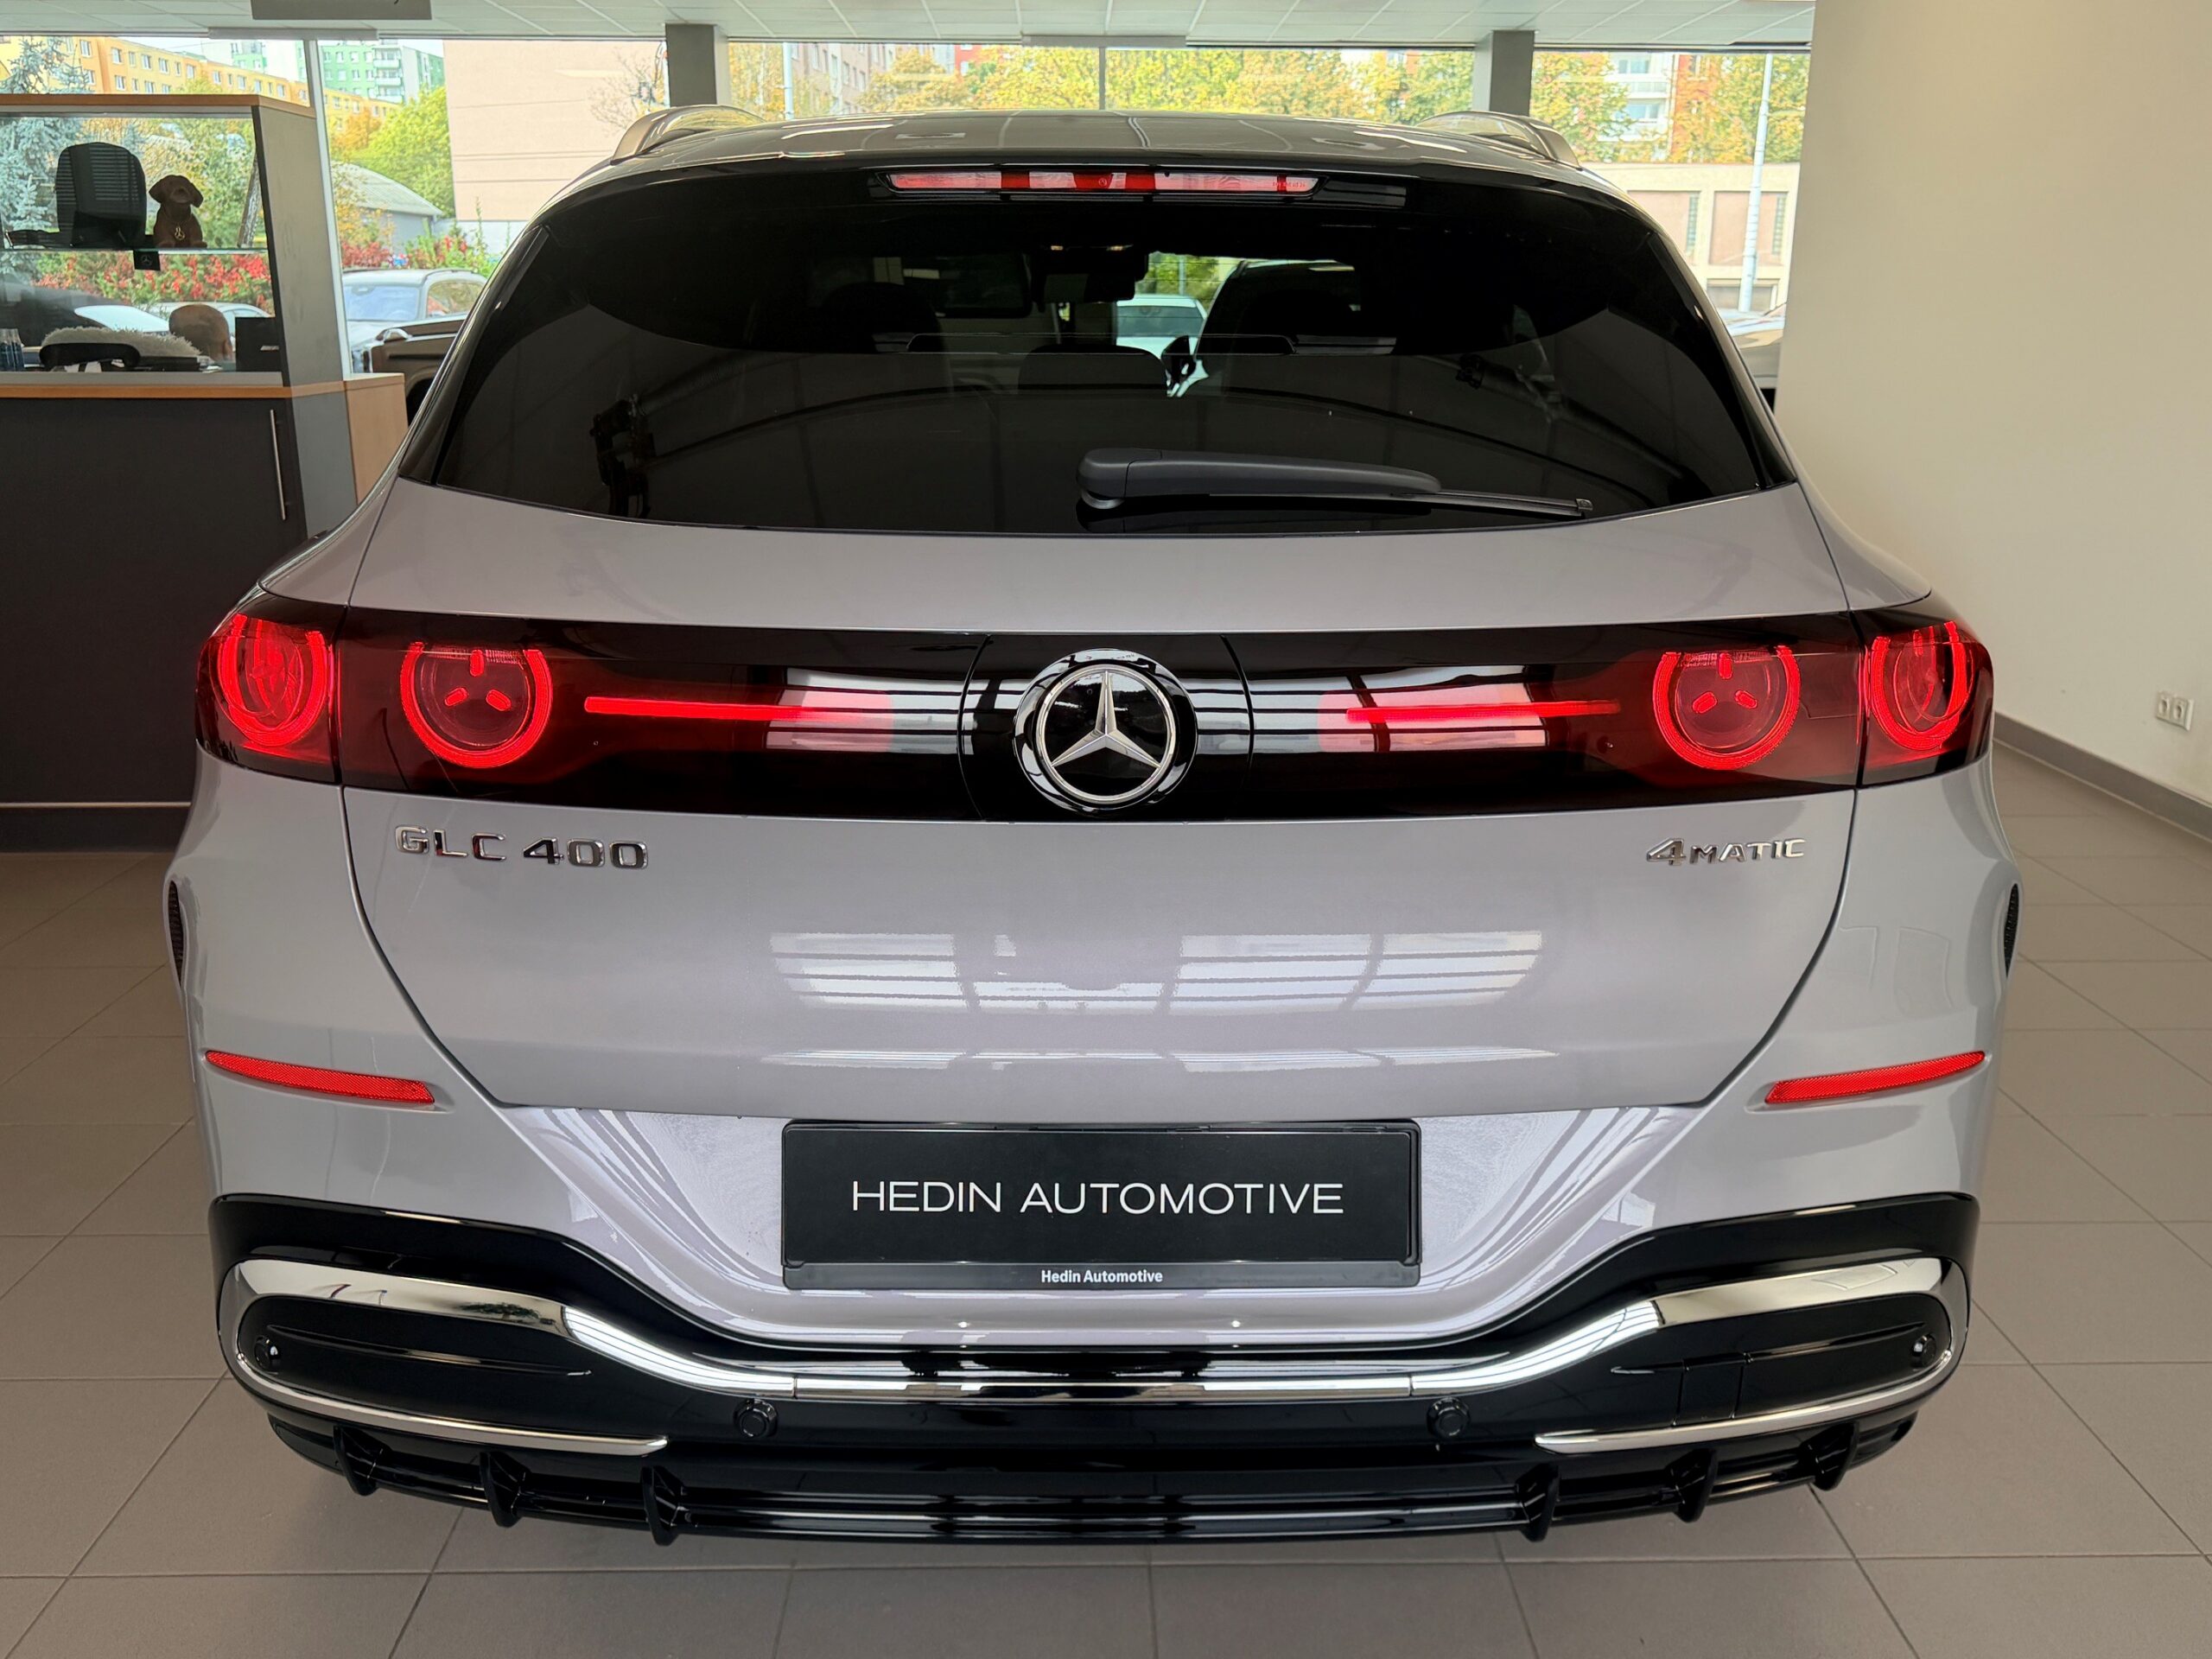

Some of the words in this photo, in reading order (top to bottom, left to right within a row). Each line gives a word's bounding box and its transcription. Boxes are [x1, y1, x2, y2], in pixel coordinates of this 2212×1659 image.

[395, 824, 507, 861] GLC
[523, 836, 649, 869] 400
[1646, 837, 1806, 866] 4MATIC
[853, 1180, 1001, 1213] HEDIN
[1020, 1182, 1344, 1215] AUTOMOTIVE
[1041, 1269, 1081, 1283] Hedin
[1083, 1269, 1163, 1283] Automotive
